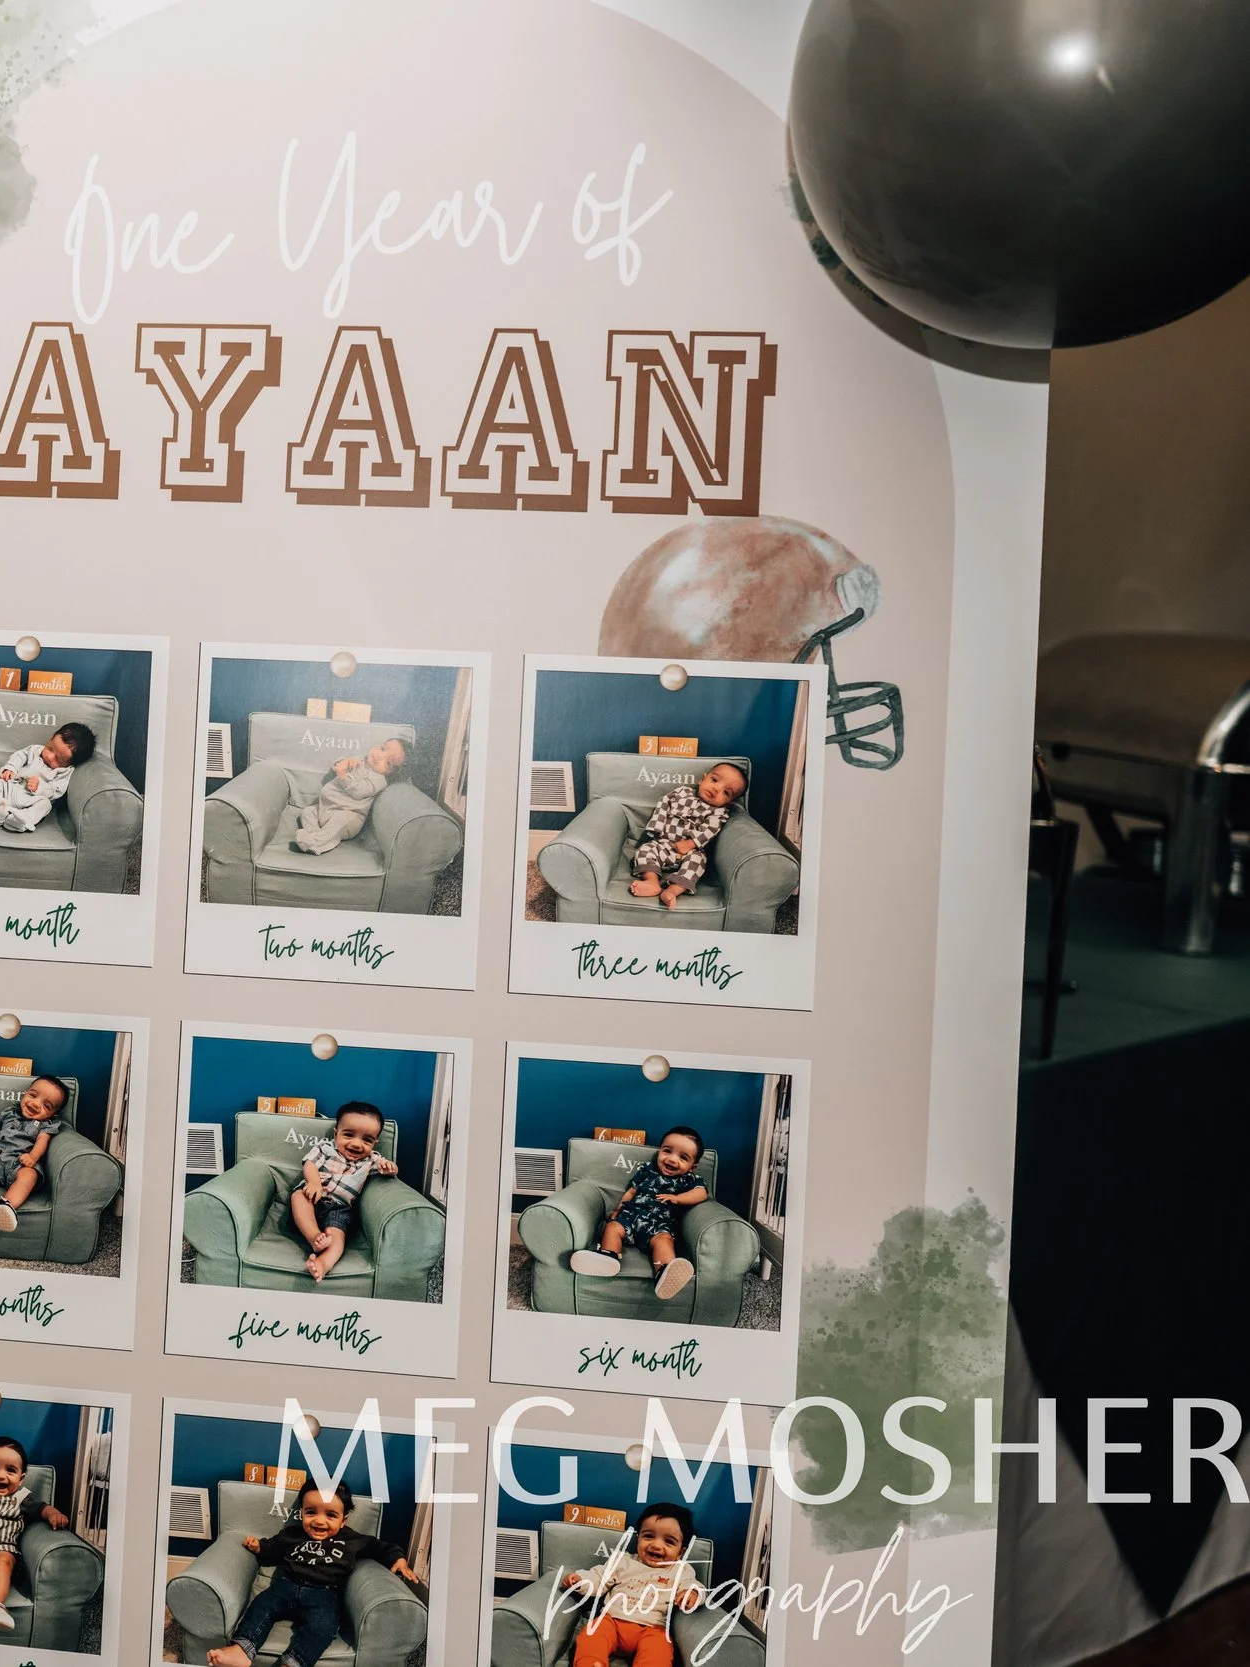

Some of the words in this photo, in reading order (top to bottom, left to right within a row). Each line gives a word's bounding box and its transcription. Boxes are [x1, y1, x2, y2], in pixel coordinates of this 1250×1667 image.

[64, 153, 234, 325] One
[278, 130, 542, 319] Year
[572, 142, 674, 286] of
[4, 671, 15, 688] 1
[30, 677, 68, 690] months
[299, 729, 360, 751] Ayaan
[643, 738, 653, 752] 3
[660, 742, 693, 753] months
[636, 765, 695, 787] Ayaan
[5, 902, 80, 948] month
[311, 927, 395, 970] months
[571, 939, 648, 980] three
[656, 946, 743, 990] months
[261, 1098, 271, 1113] 5
[279, 1102, 311, 1115] months
[598, 1129, 607, 1141] 6
[612, 1133, 641, 1144] months
[228, 1311, 289, 1349] five
[297, 1311, 382, 1354] months
[578, 1341, 625, 1377] six
[632, 1339, 702, 1380] month
[248, 1466, 259, 1482] 8
[269, 1503, 303, 1523] Aya
[570, 1507, 580, 1522] 9
[586, 1513, 621, 1527] months
